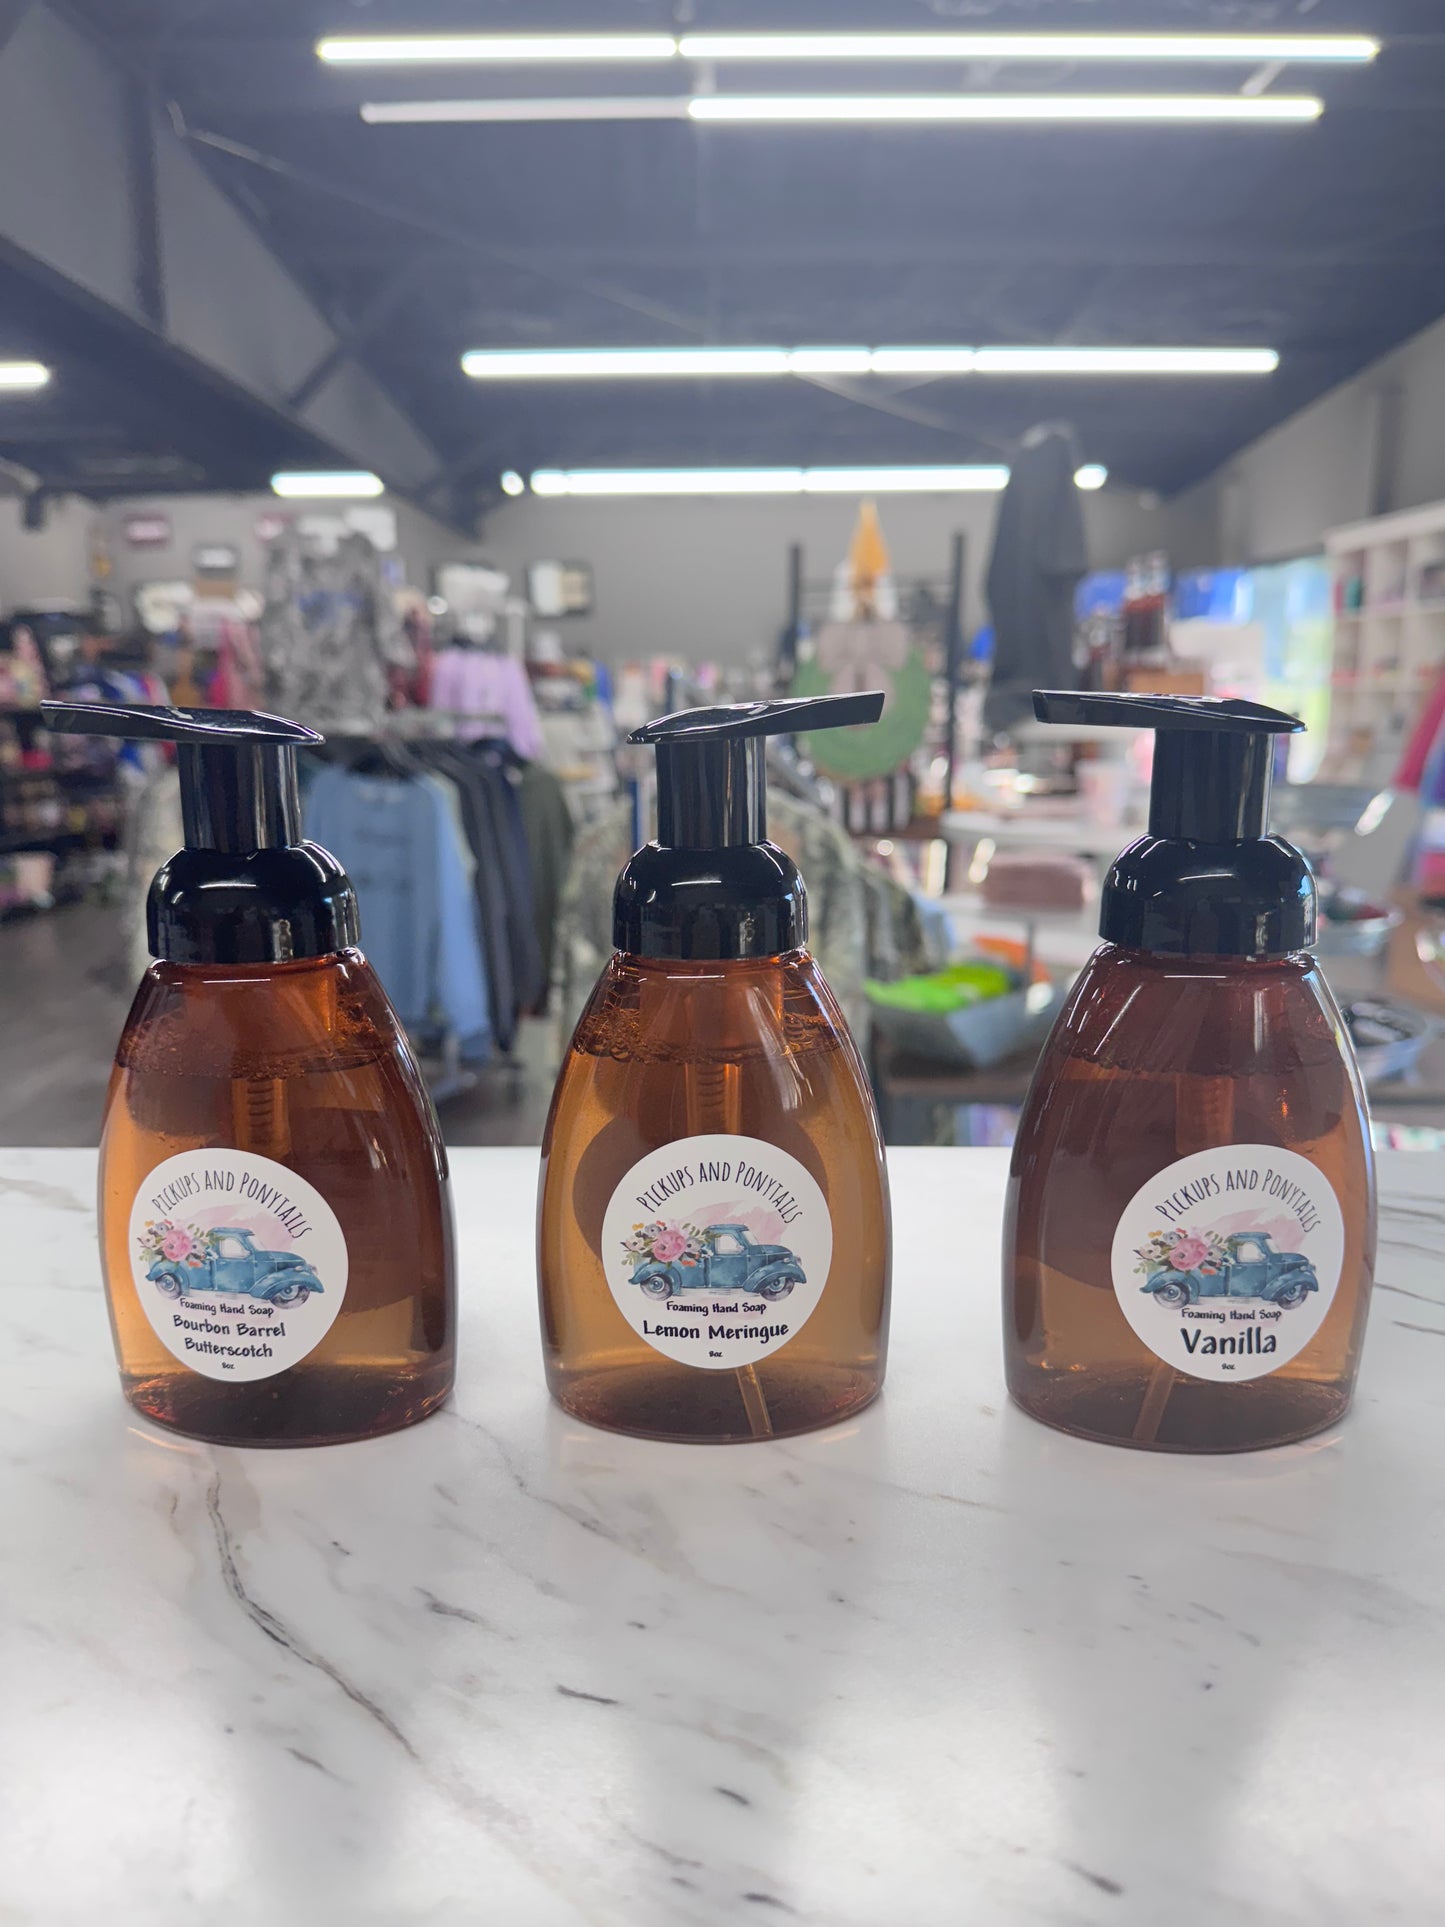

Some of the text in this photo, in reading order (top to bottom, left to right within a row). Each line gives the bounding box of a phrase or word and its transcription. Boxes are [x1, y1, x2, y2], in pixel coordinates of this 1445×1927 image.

[636, 1161, 803, 1224] PICKUPS AND PONYTAILS
[1155, 1169, 1321, 1233] PICKUPS AND PONYTAILS
[152, 1170, 312, 1239] PICKUPS AND PONYTAILS
[180, 1298, 274, 1318] Foaming Hand Soap
[666, 1301, 766, 1316] Foaming Hand Soap
[1181, 1308, 1282, 1323] Foaming Hand Soap
[173, 1315, 286, 1336] Bourbon Barrel
[643, 1320, 789, 1343] Lemon Meringue
[185, 1338, 273, 1357] Butterscotch
[1181, 1327, 1276, 1354] Vanilla
